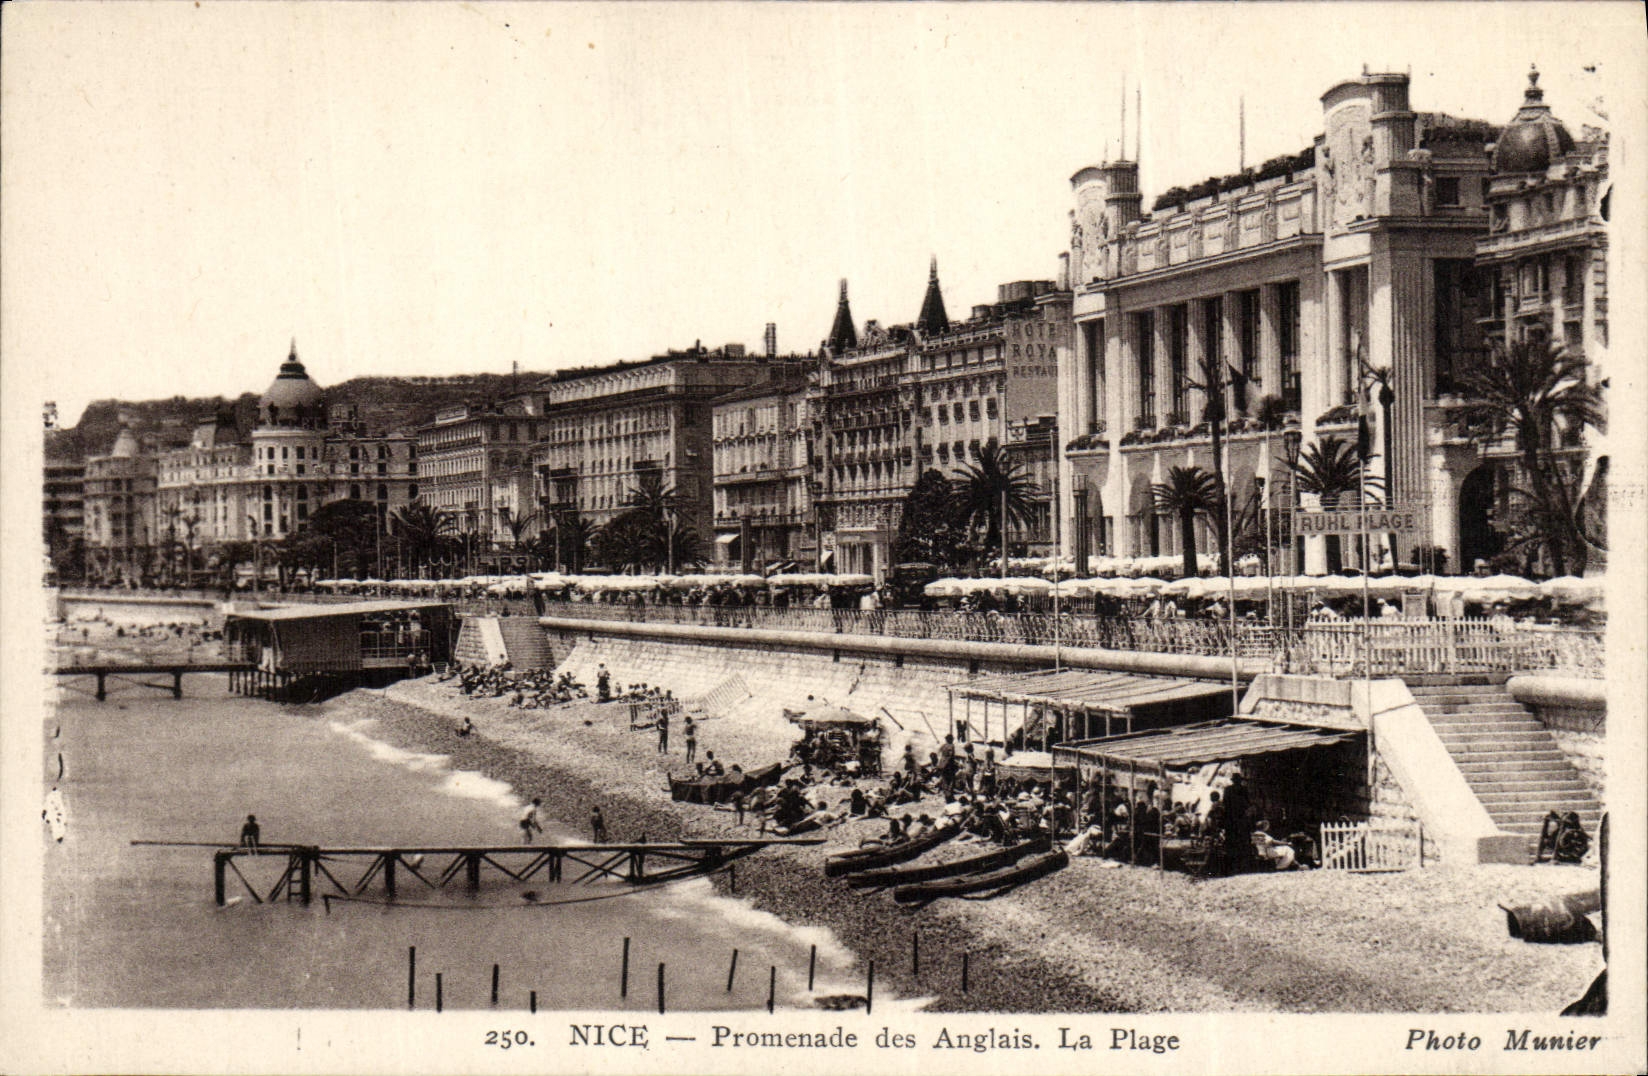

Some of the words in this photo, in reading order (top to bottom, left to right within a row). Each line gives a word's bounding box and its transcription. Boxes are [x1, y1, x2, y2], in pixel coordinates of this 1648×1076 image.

[1012, 343, 1057, 359] ROYA
[1013, 365, 1058, 377] RESTAU
[1301, 515, 1350, 531] RUHL
